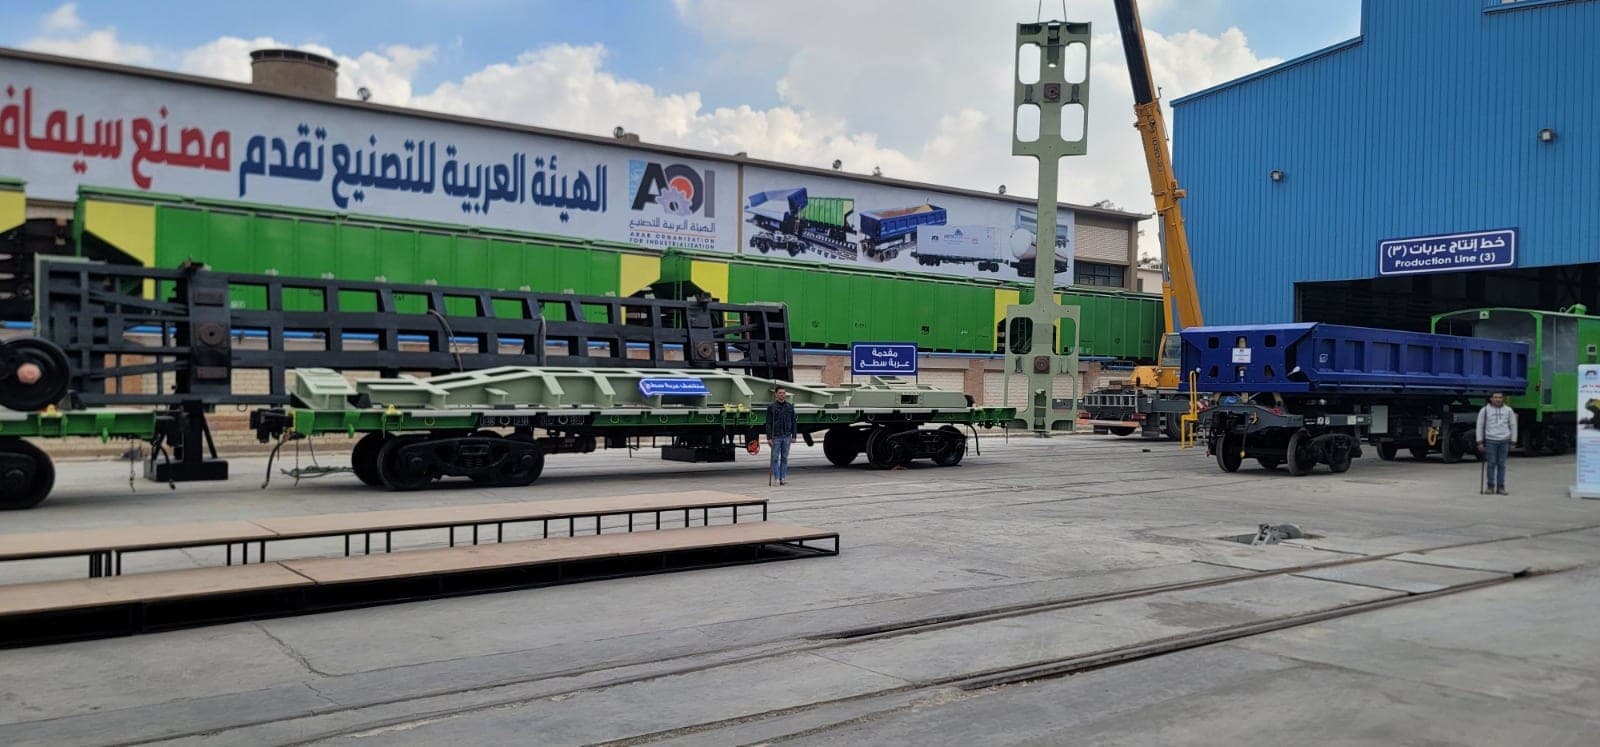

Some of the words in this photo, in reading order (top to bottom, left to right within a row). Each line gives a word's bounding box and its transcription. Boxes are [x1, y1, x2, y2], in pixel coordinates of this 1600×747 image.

[131, 105, 231, 189] مصنع
[239, 123, 327, 198] تقدم
[332, 134, 436, 208] للتصنيع
[442, 143, 526, 215] العربية
[531, 155, 607, 223] الهيئة
[629, 217, 660, 229] للتصنيع
[662, 219, 688, 232] العربية
[690, 222, 716, 233] الهيئة
[630, 231, 651, 239] ARAB
[655, 231, 715, 243] ORGANIZATION
[1480, 236, 1505, 249] خط
[646, 239, 715, 249] INDUSTRIALIZATION
[1409, 243, 1446, 255] عربات
[1449, 238, 1478, 252] إنتاج
[1395, 257, 1452, 268] Production
[1454, 254, 1477, 263] Line
[1479, 252, 1496, 263] (3)
[872, 347, 898, 358] مقدمة
[860, 359, 887, 368] سطح
[889, 358, 910, 368] عربة
